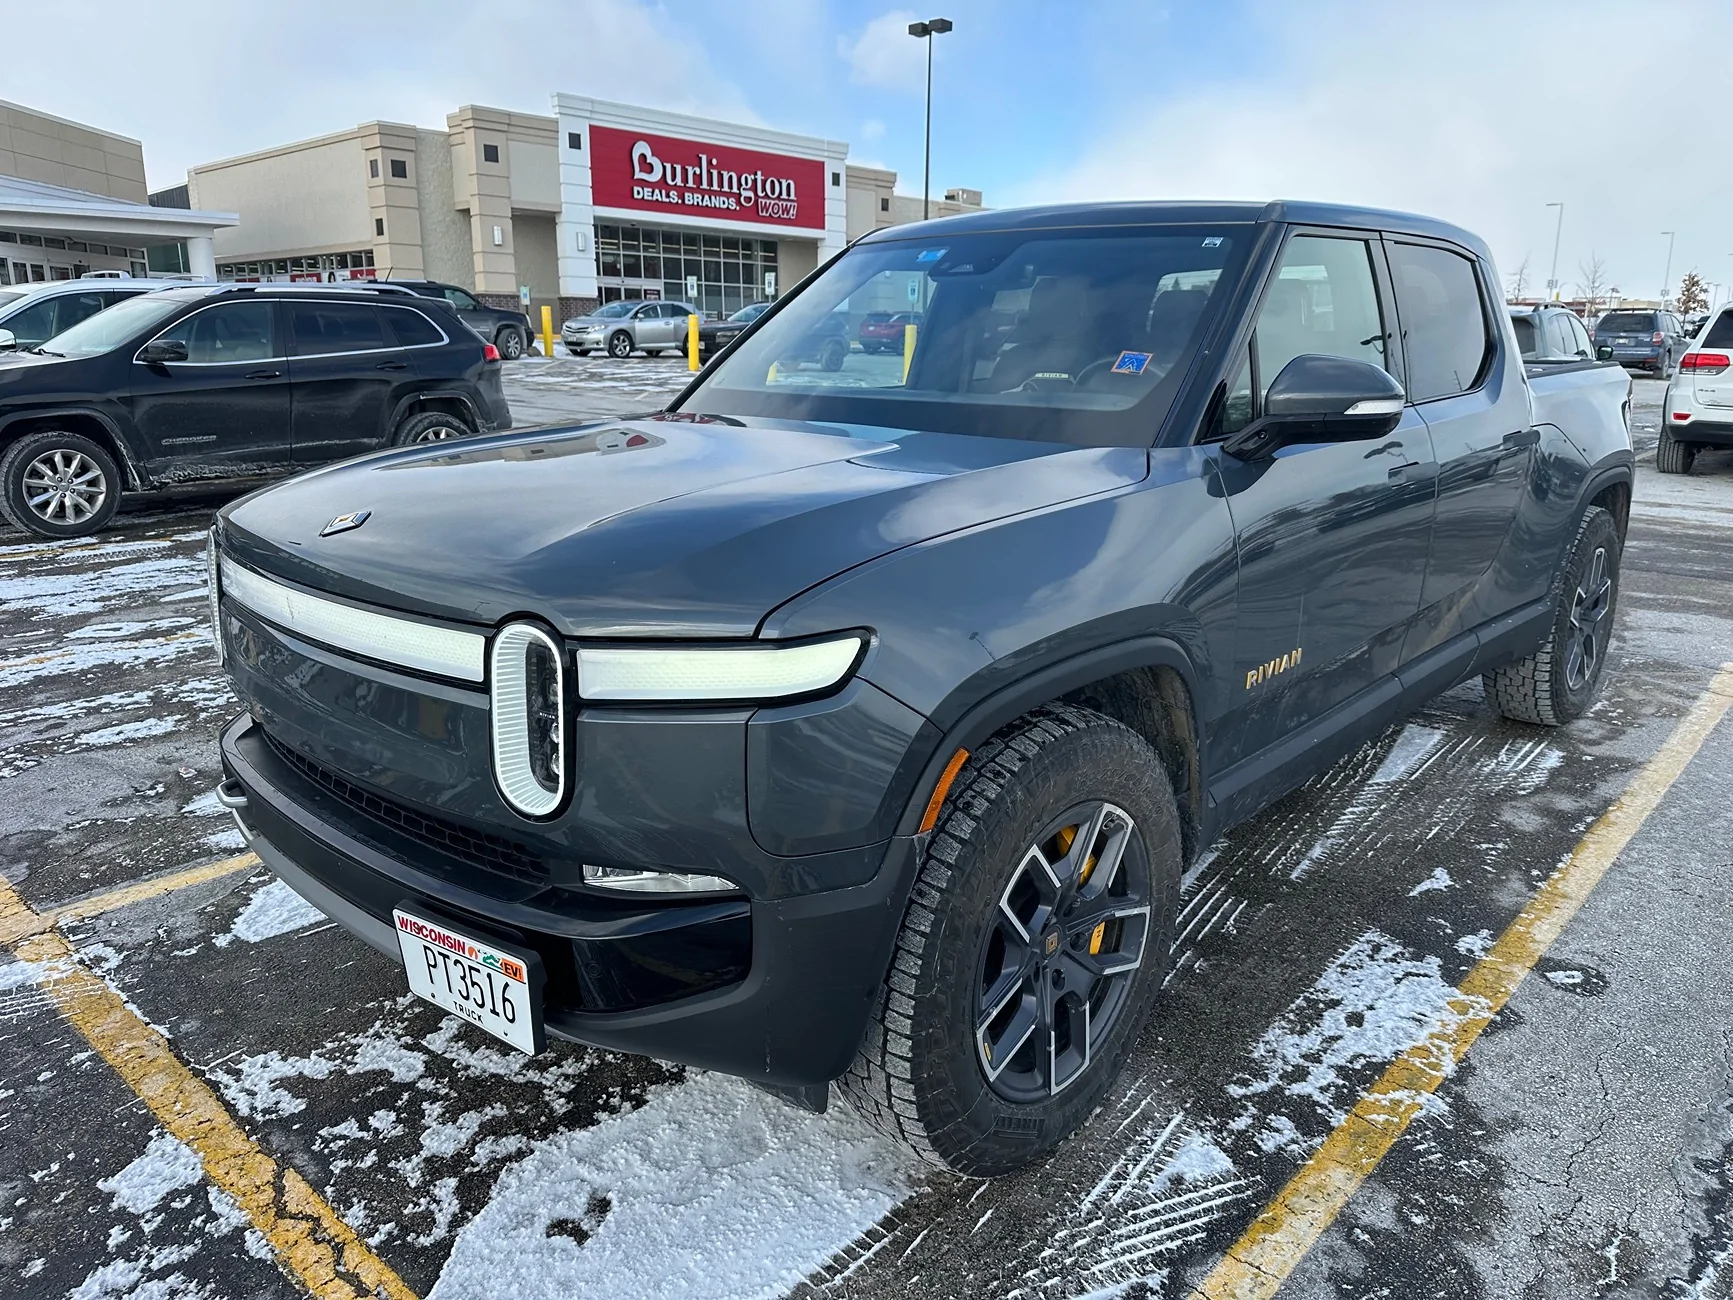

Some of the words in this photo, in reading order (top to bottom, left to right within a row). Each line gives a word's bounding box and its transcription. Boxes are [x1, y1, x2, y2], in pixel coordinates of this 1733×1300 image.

[631, 140, 797, 207] Burlington
[633, 185, 682, 204] DEALS.
[684, 191, 740, 211] BRANDS.
[757, 199, 797, 220] WOW!
[1246, 647, 1302, 690] RIVIAN
[397, 915, 466, 955] WISCONSIN
[422, 944, 516, 1024] PT3516
[453, 1000, 484, 1024] TRUCK
